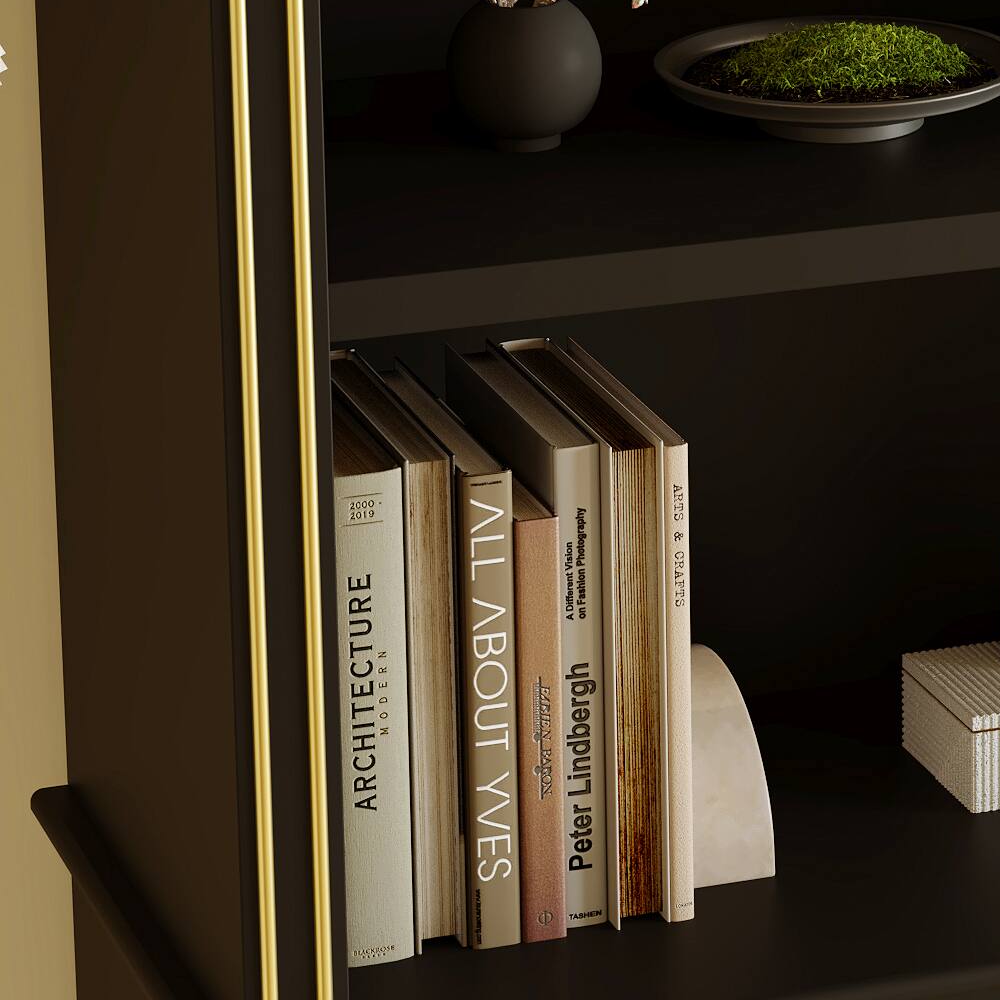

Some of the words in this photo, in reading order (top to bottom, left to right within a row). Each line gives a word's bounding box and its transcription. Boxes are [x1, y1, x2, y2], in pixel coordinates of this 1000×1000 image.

[349, 499, 375, 510] 2000
[350, 509, 375, 520] 2019
[673, 484, 684, 521] ARTS
[470, 498, 505, 582] ALL
[564, 541, 573, 571] Vision
[575, 507, 587, 567] Photography
[674, 531, 682, 541] &
[564, 573, 574, 611] Different
[576, 568, 587, 607] Fashion
[674, 551, 685, 607] CRAFTS
[566, 611, 574, 620] A
[578, 608, 587, 619] on
[347, 573, 377, 811] ARCHITECTURE
[378, 649, 389, 735] MODERN
[473, 597, 511, 751] ABOUT
[540, 686, 552, 741] FABIEN
[565, 662, 597, 796] Lindbergh
[475, 771, 512, 882] YVES
[568, 804, 593, 871] Peter
[353, 944, 395, 957] BLACKROSE
